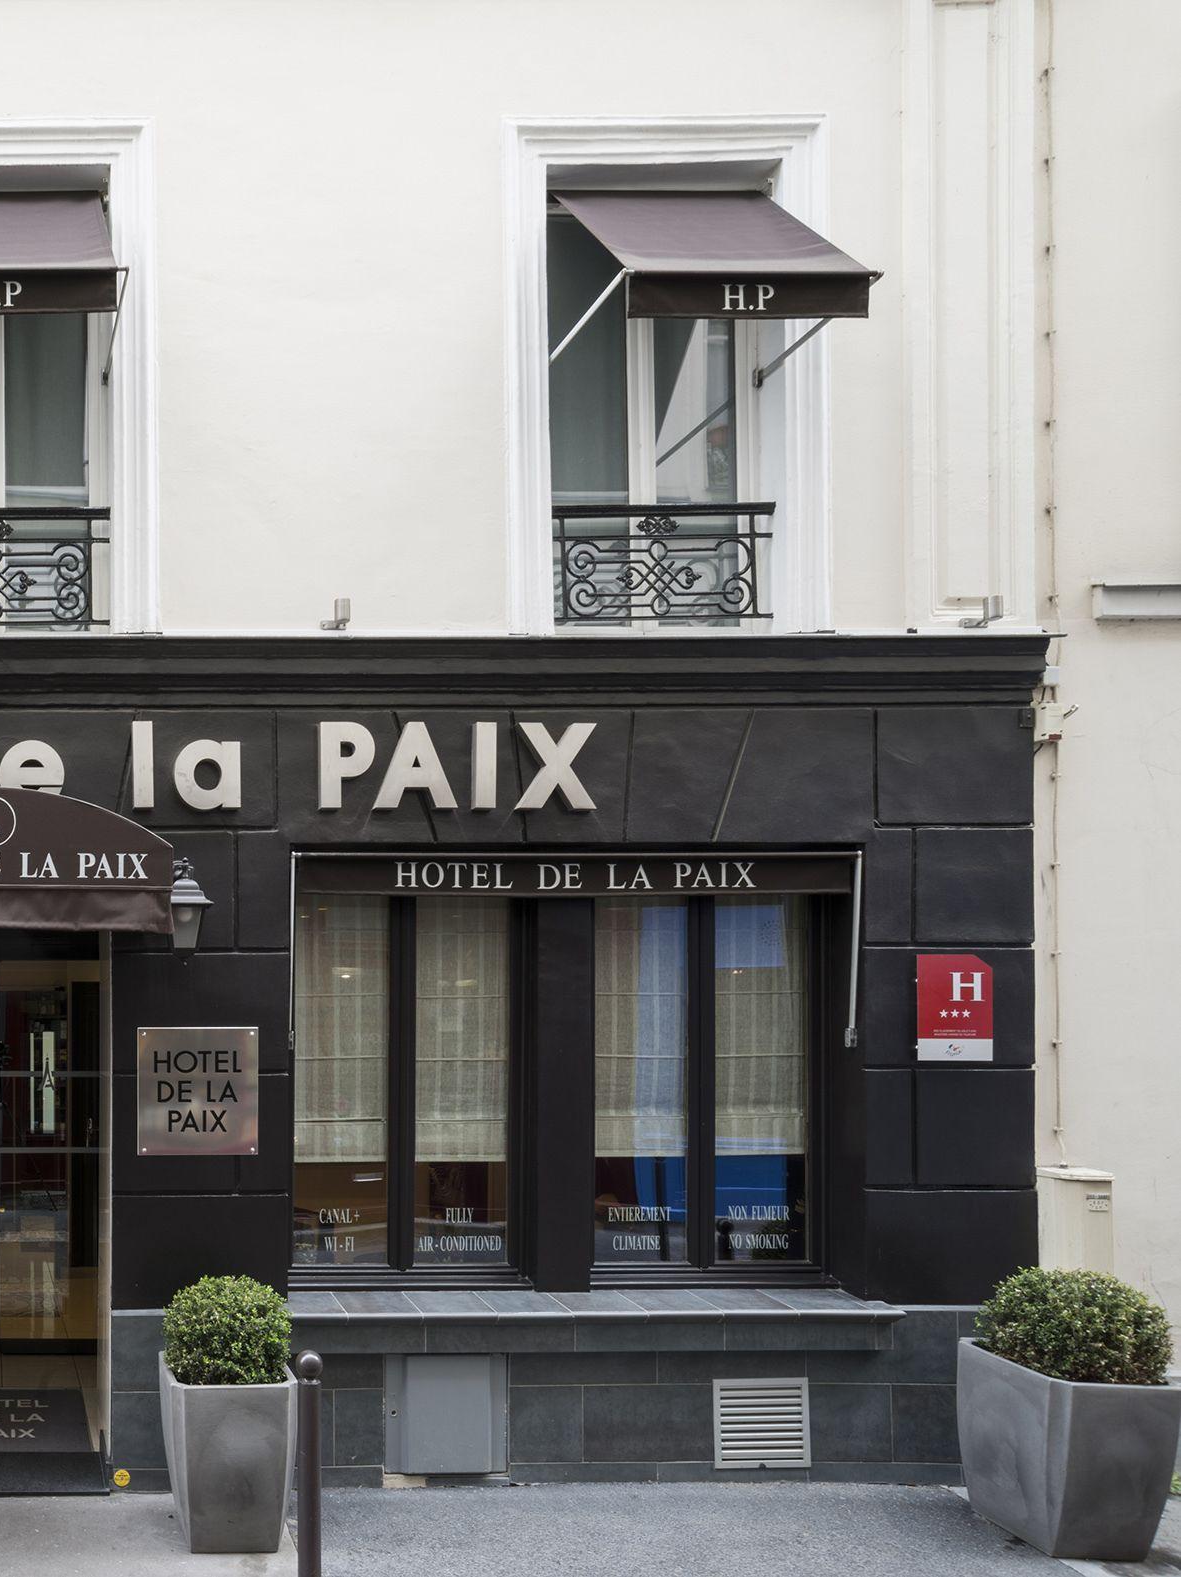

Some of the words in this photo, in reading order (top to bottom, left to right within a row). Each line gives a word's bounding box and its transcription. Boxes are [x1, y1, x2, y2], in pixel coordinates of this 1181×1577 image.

[721, 284, 775, 310] H.P
[132, 720, 241, 810] la
[317, 721, 597, 811] PAIX
[20, 852, 60, 879] LA
[77, 852, 148, 880] PAIX
[394, 861, 513, 889] HOTEL
[537, 862, 583, 890] DE
[606, 862, 653, 890] LA
[673, 861, 757, 889] PAIX
[949, 971, 986, 1002] H
[153, 1050, 242, 1073] HOTEL
[157, 1080, 192, 1103] DE
[206, 1080, 238, 1103] LA
[167, 1110, 227, 1133] PAIX
[445, 1207, 474, 1224] FULLY
[608, 1206, 672, 1222] ENTIEREMENT
[727, 1205, 747, 1221] NON
[751, 1205, 790, 1221] FUMEUR
[612, 1235, 661, 1251] CLIMATISE
[728, 1234, 742, 1249] NO
[745, 1233, 789, 1250] SMOKING
[11, 1413, 45, 1422] LA
